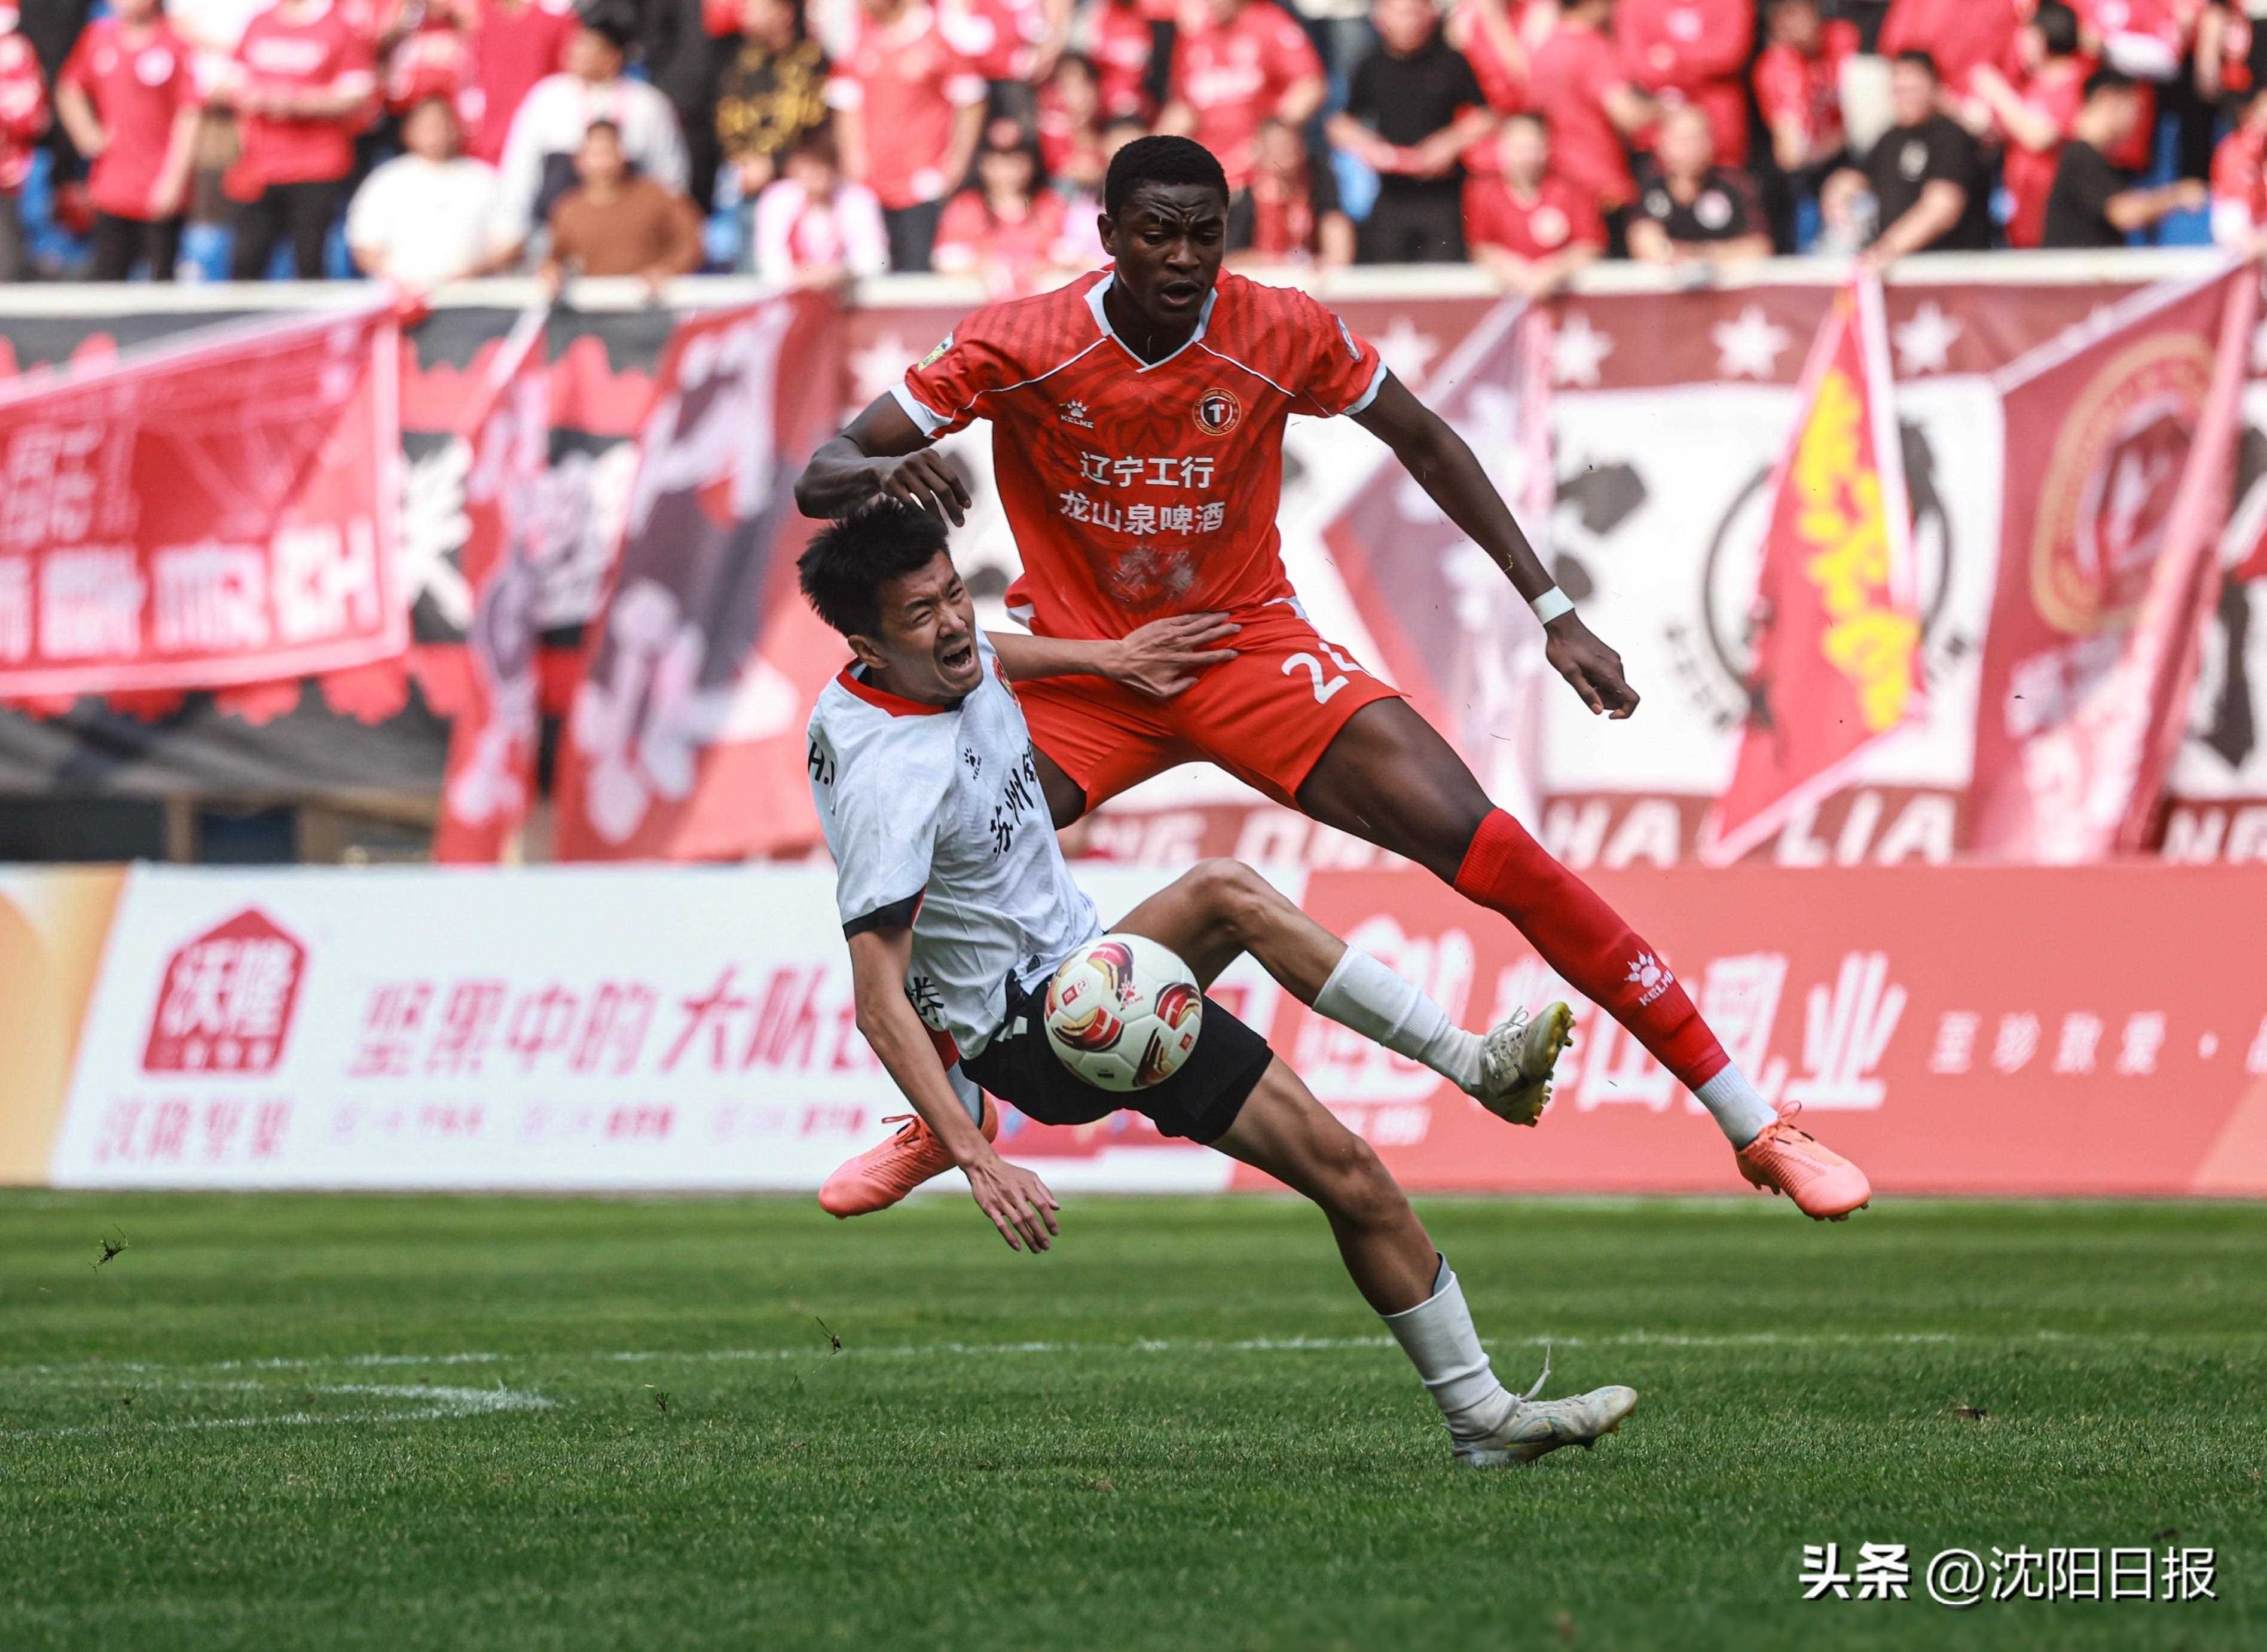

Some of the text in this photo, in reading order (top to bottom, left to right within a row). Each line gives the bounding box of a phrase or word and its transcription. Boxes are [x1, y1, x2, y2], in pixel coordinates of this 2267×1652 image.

[1060, 414, 1094, 429] KELME
[1080, 451, 1214, 488] 辽宁工行
[1059, 490, 1225, 536] 龙山泉啤酒
[808, 741, 835, 788] H.
[972, 754, 982, 782] KELME
[1638, 969, 1674, 1007] KELM
